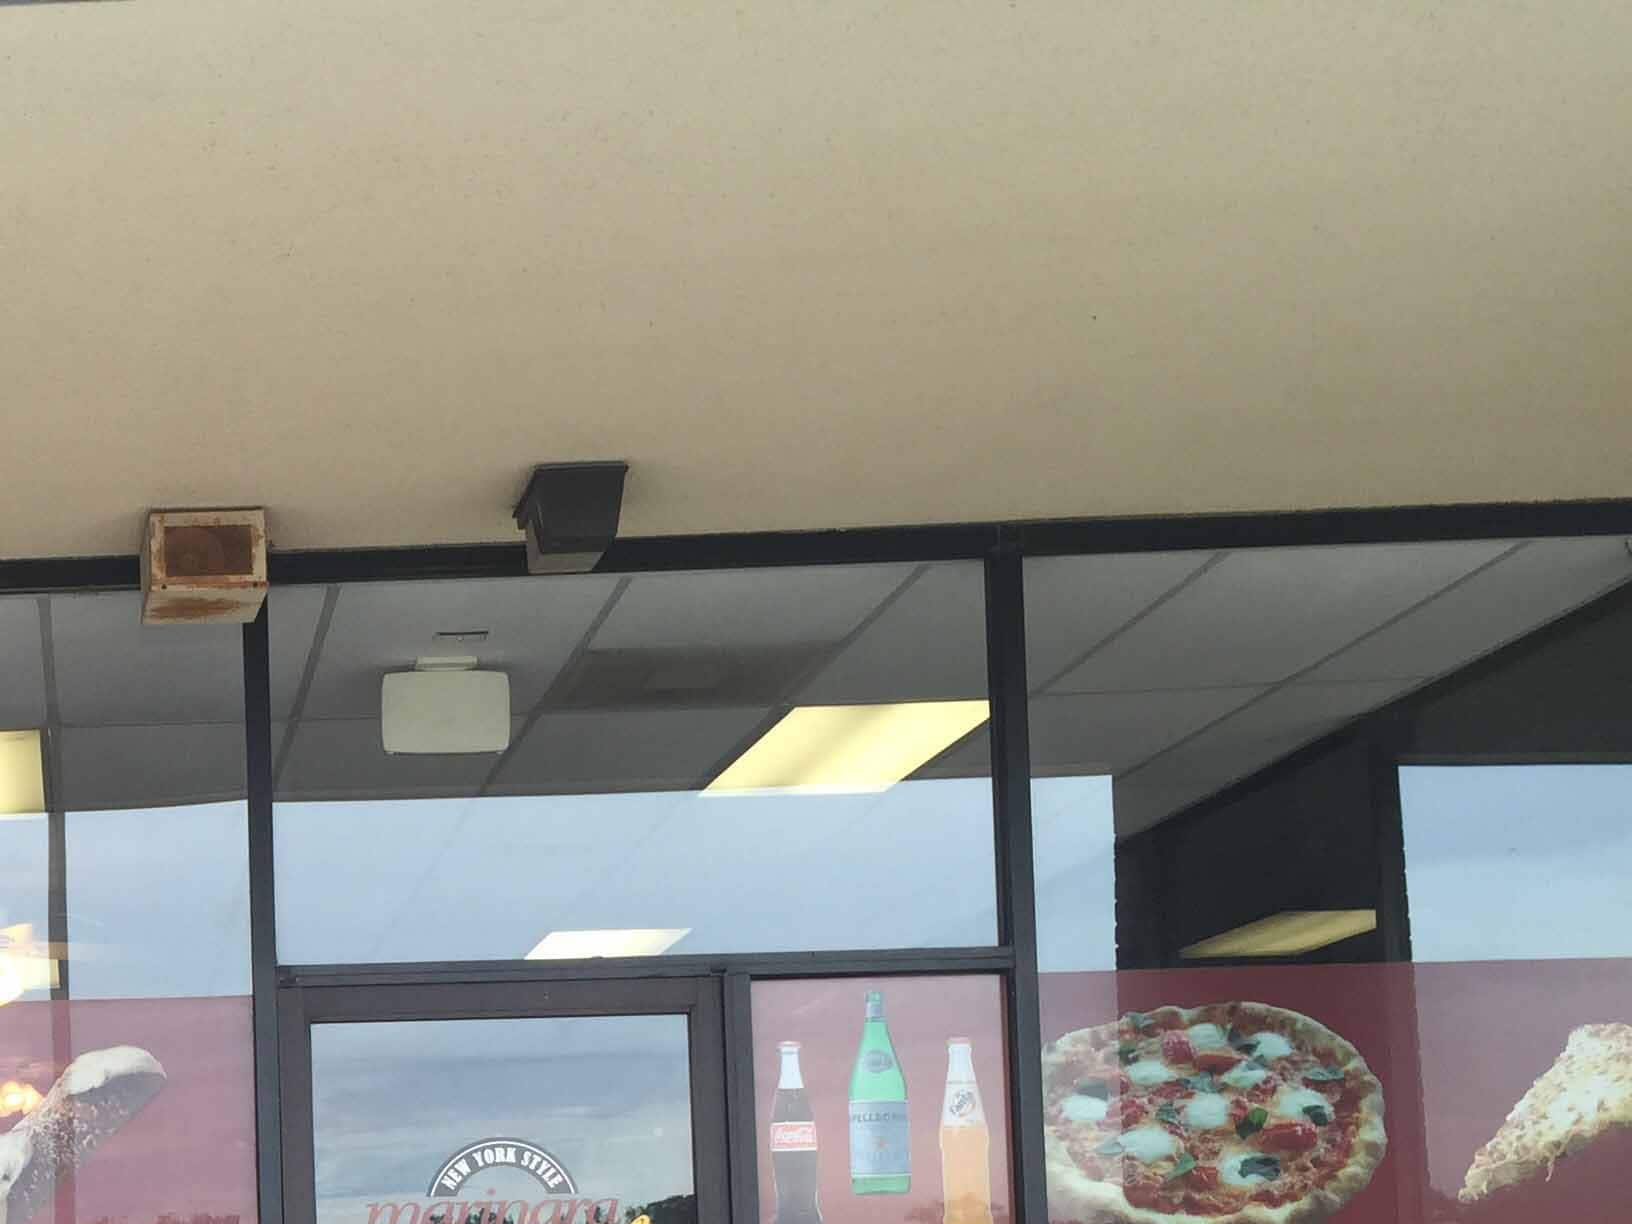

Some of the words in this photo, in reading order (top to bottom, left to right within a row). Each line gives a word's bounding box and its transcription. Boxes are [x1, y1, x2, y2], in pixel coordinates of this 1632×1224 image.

[441, 1159, 472, 1190] NEW
[473, 1147, 517, 1167] YORK
[520, 1149, 563, 1188] STYLE
